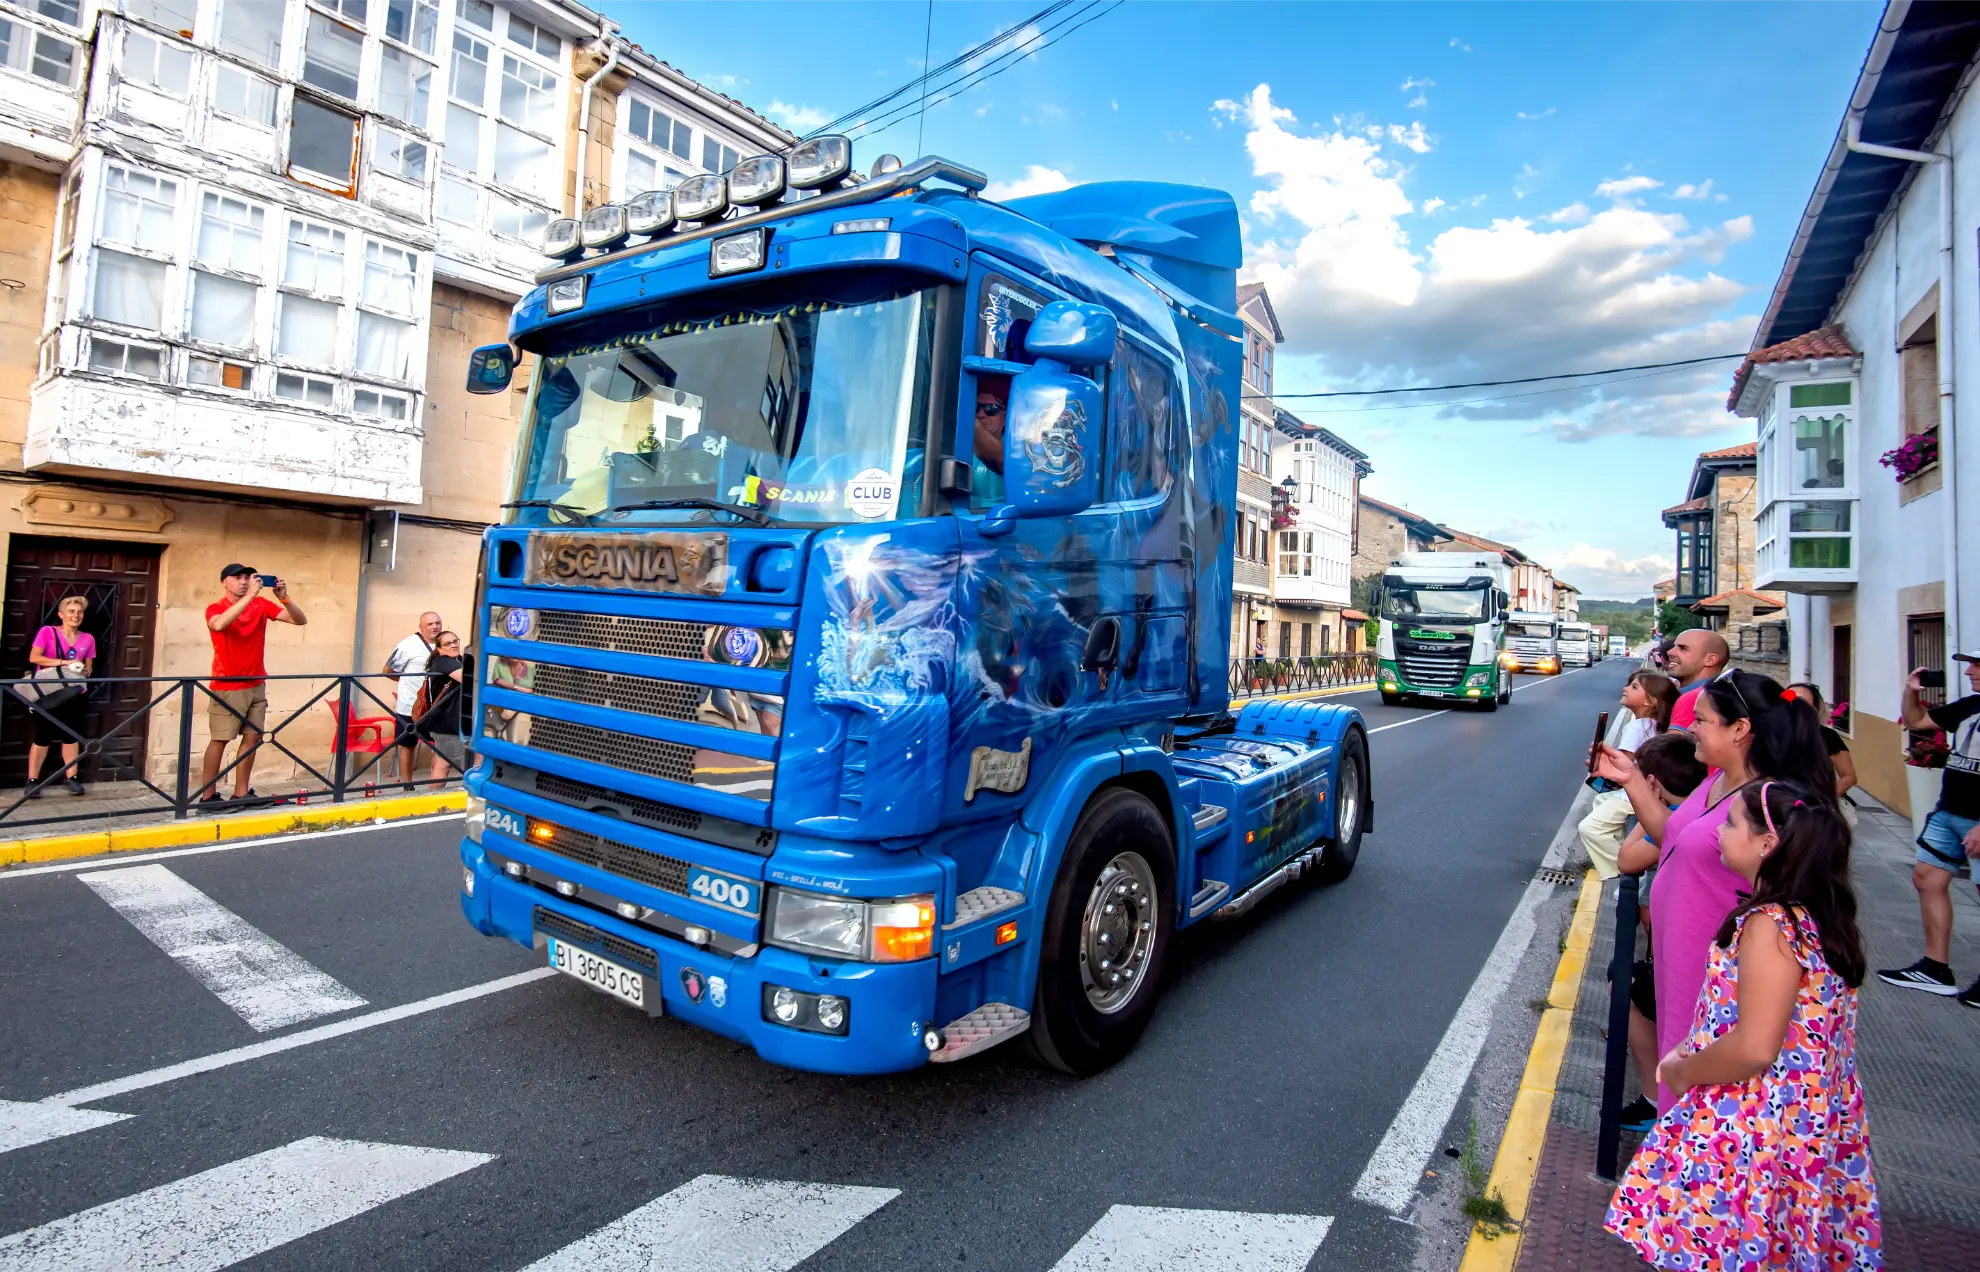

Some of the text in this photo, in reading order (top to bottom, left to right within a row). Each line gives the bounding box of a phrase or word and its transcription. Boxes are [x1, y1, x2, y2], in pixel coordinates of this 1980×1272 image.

[853, 486, 892, 500] CLUB
[557, 544, 678, 582] SCANIA
[1418, 644, 1447, 652] DAF
[692, 874, 750, 908] 400
[556, 943, 642, 1001] BI 3605 CS
